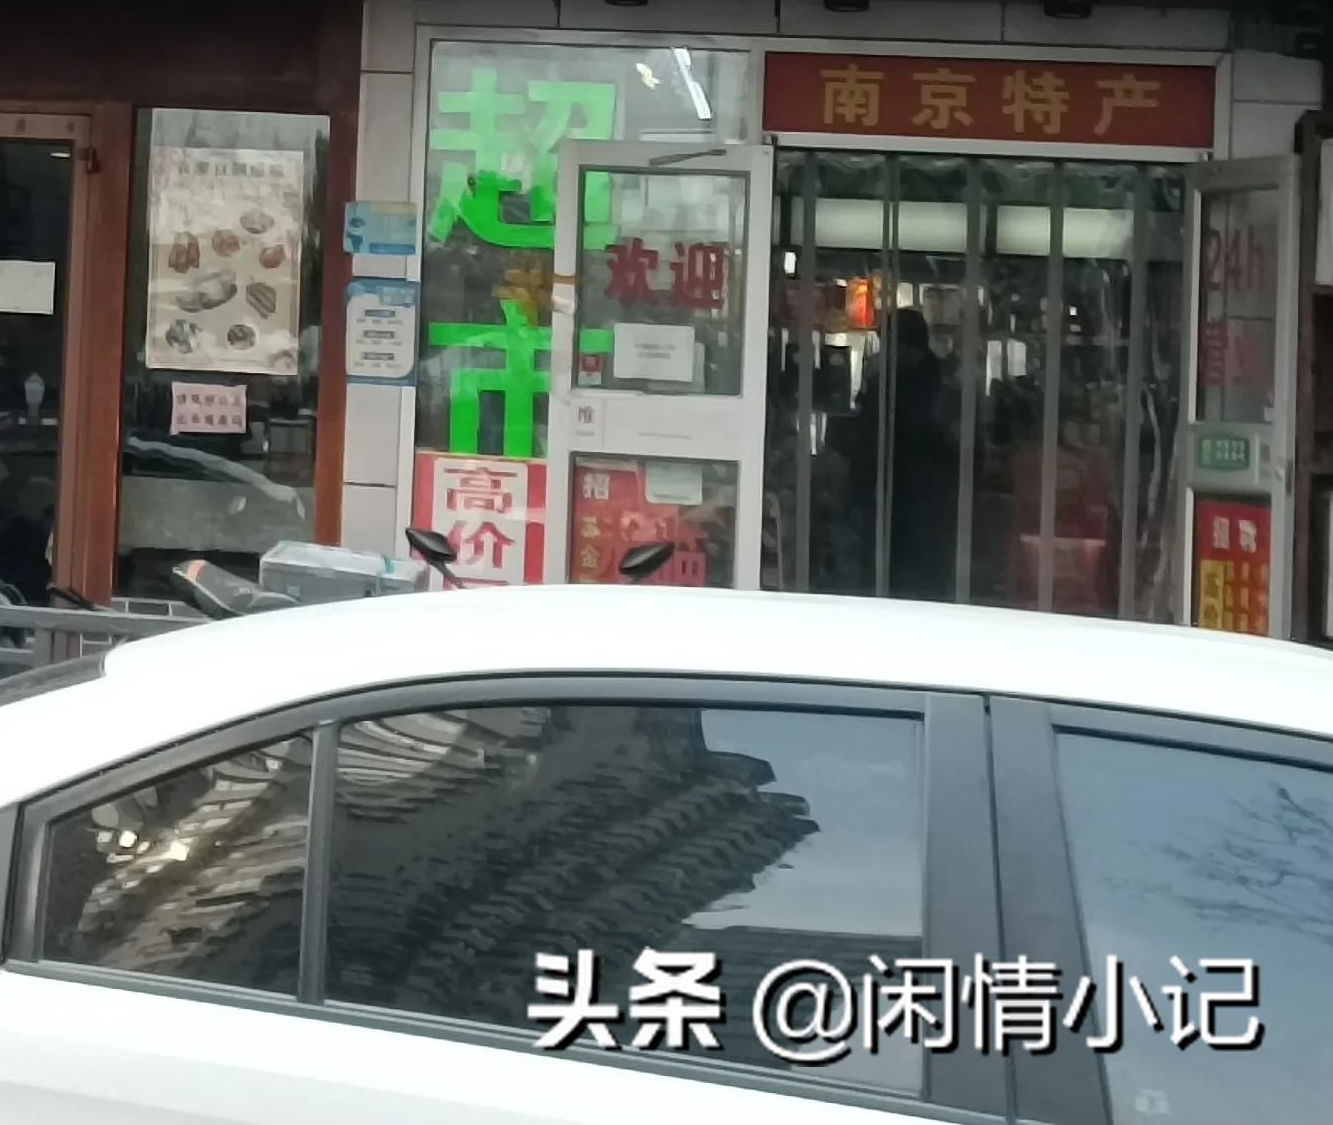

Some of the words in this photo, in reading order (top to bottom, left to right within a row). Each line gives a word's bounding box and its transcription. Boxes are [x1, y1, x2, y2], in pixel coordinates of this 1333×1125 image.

[820, 64, 1162, 135] 南京特产
[427, 67, 617, 456] 超市
[603, 237, 725, 311] 欢迎
